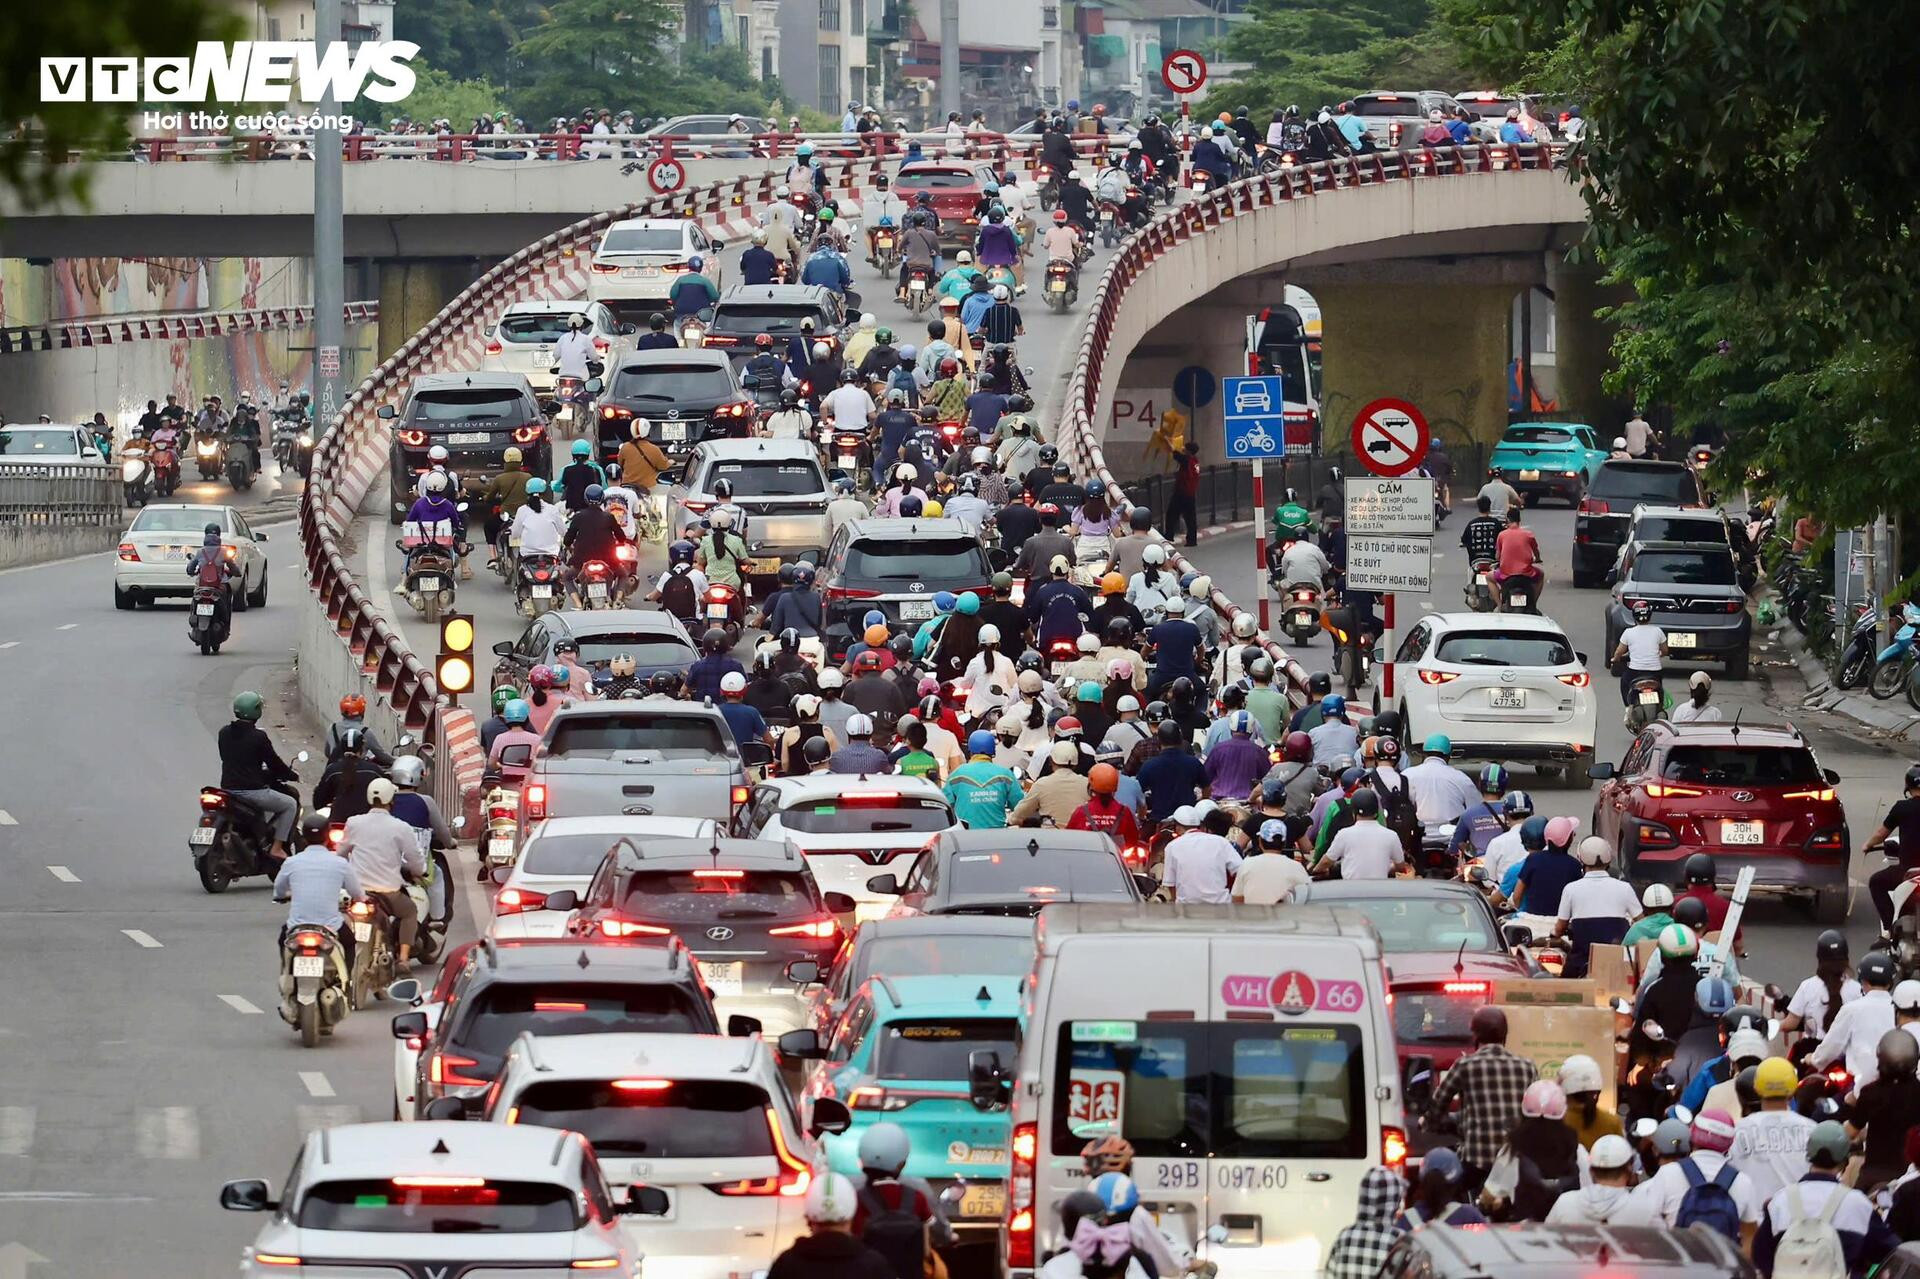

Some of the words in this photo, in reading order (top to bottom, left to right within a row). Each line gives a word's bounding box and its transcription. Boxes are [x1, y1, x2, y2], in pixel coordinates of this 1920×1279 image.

[1112, 399, 1156, 429] P4
[1377, 480, 1402, 494] CẤM
[1413, 544, 1429, 555] SINH
[1494, 698, 1521, 707] 477.92
[1733, 823, 1752, 833] 30H
[1726, 833, 1759, 843] 449.49
[708, 964, 731, 978] 30F
[1230, 980, 1263, 1001] VH
[1326, 985, 1356, 1008] 66
[1158, 1162, 1200, 1189] 29B
[1217, 1164, 1288, 1190] 097.60
